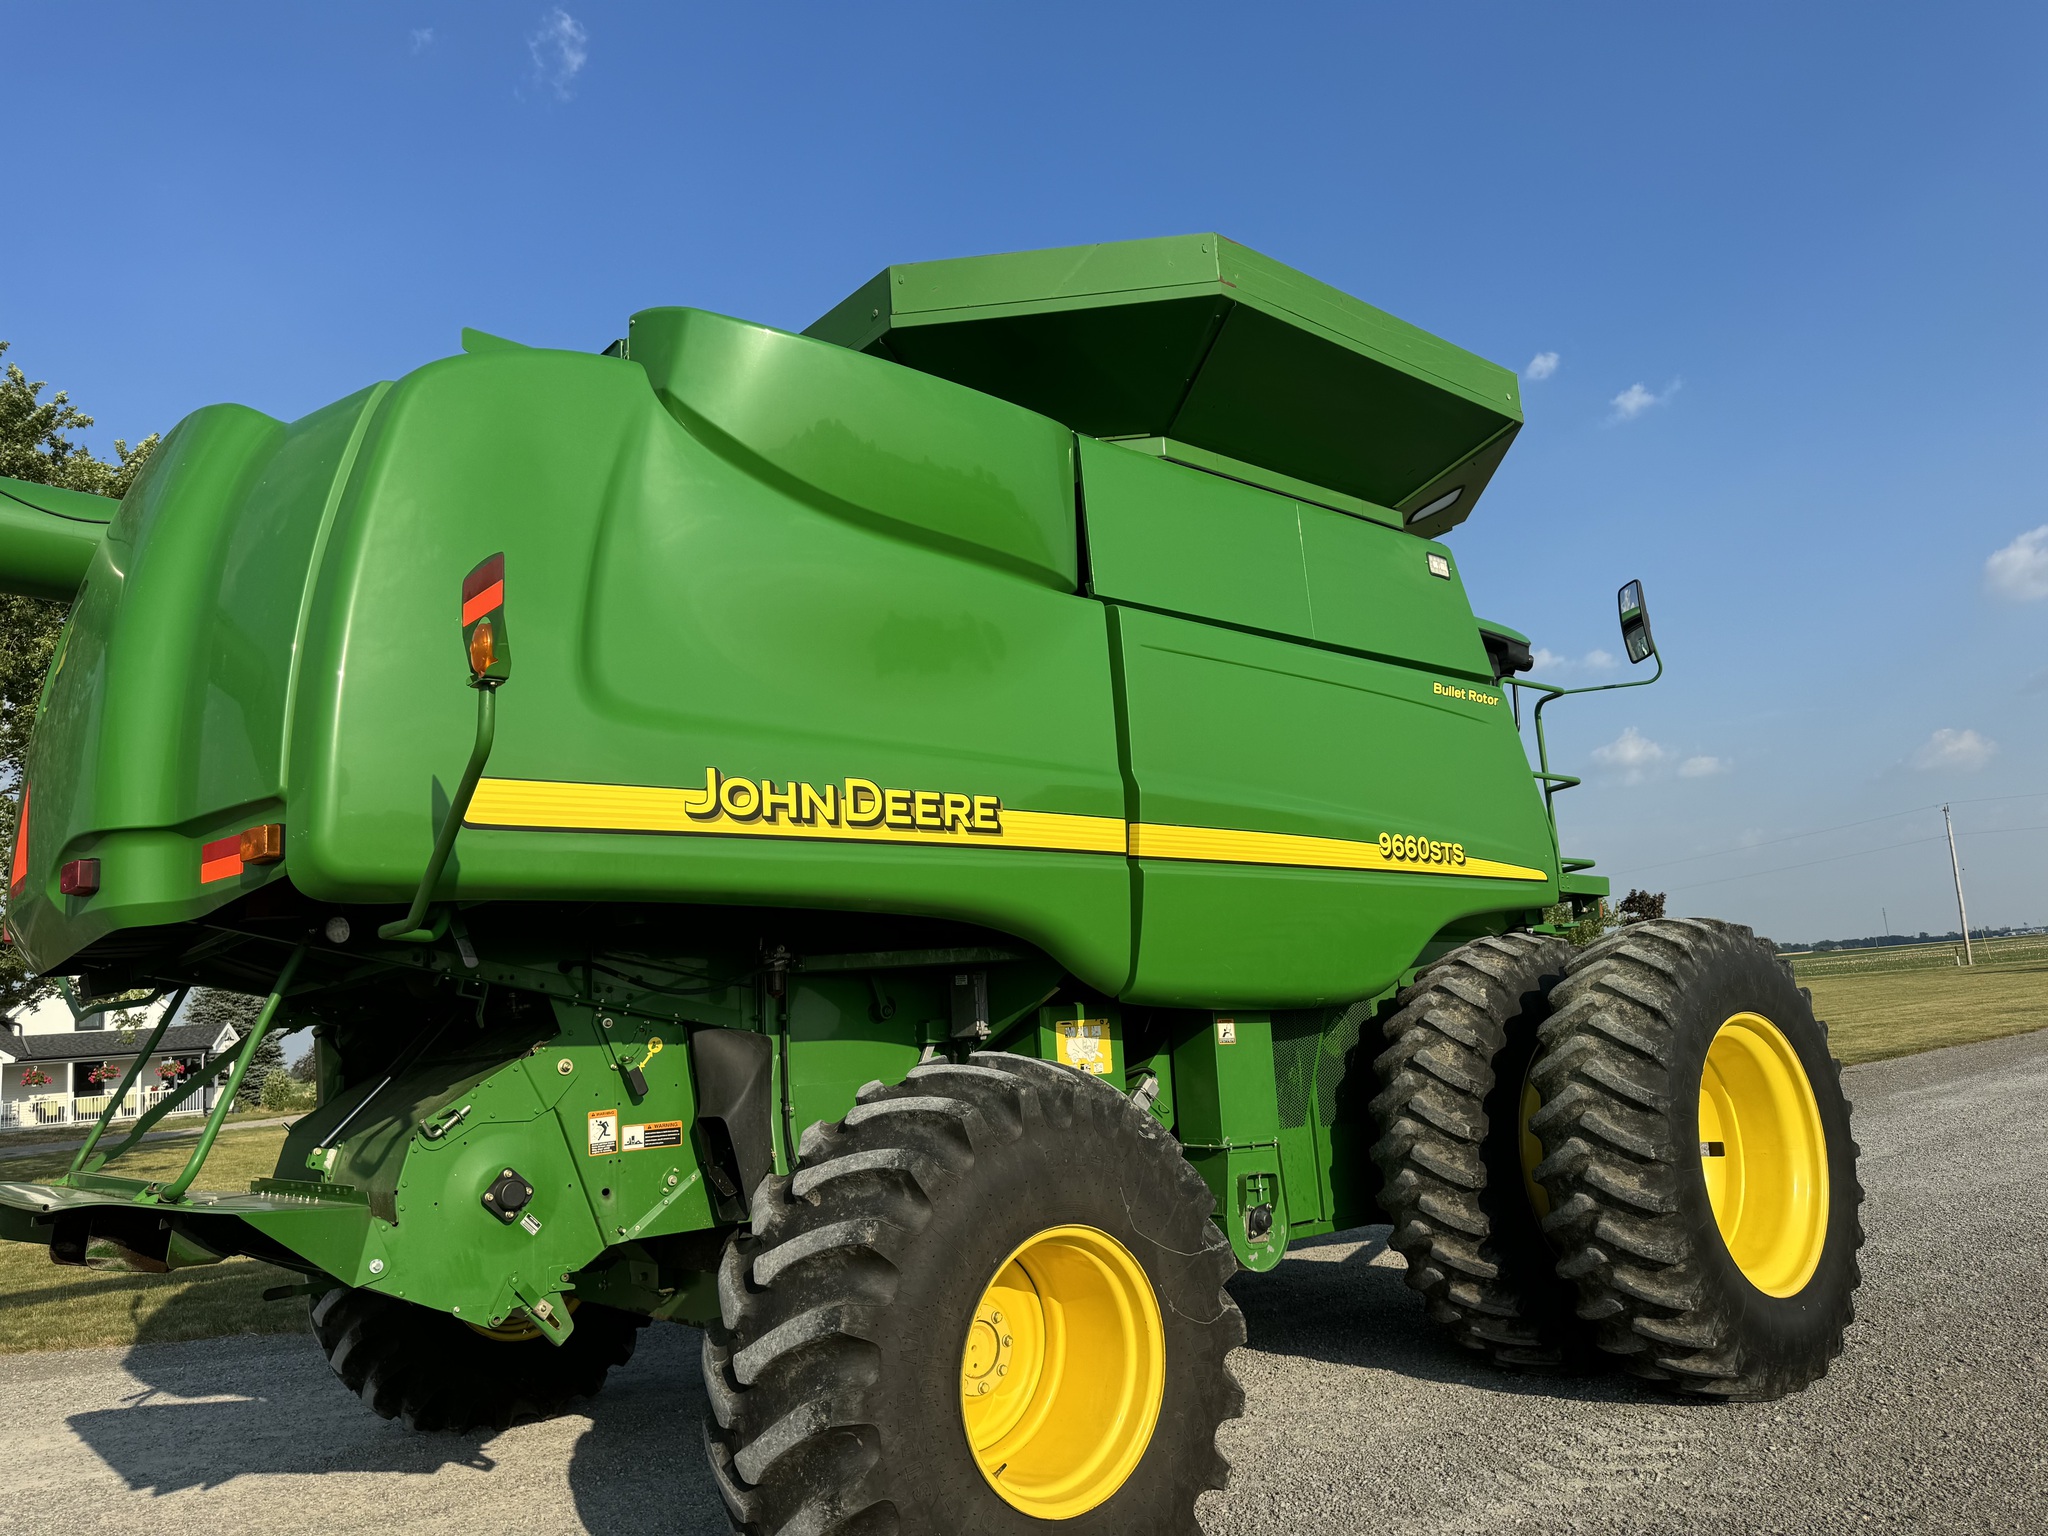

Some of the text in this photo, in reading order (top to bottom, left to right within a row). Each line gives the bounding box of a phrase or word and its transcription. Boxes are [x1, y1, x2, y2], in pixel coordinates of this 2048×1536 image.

[1433, 682, 1499, 706] Bullet Rotor
[684, 766, 1003, 835] JOHN DEERE
[1378, 831, 1466, 866] 9660STS
[653, 1121, 679, 1129] WARNING
